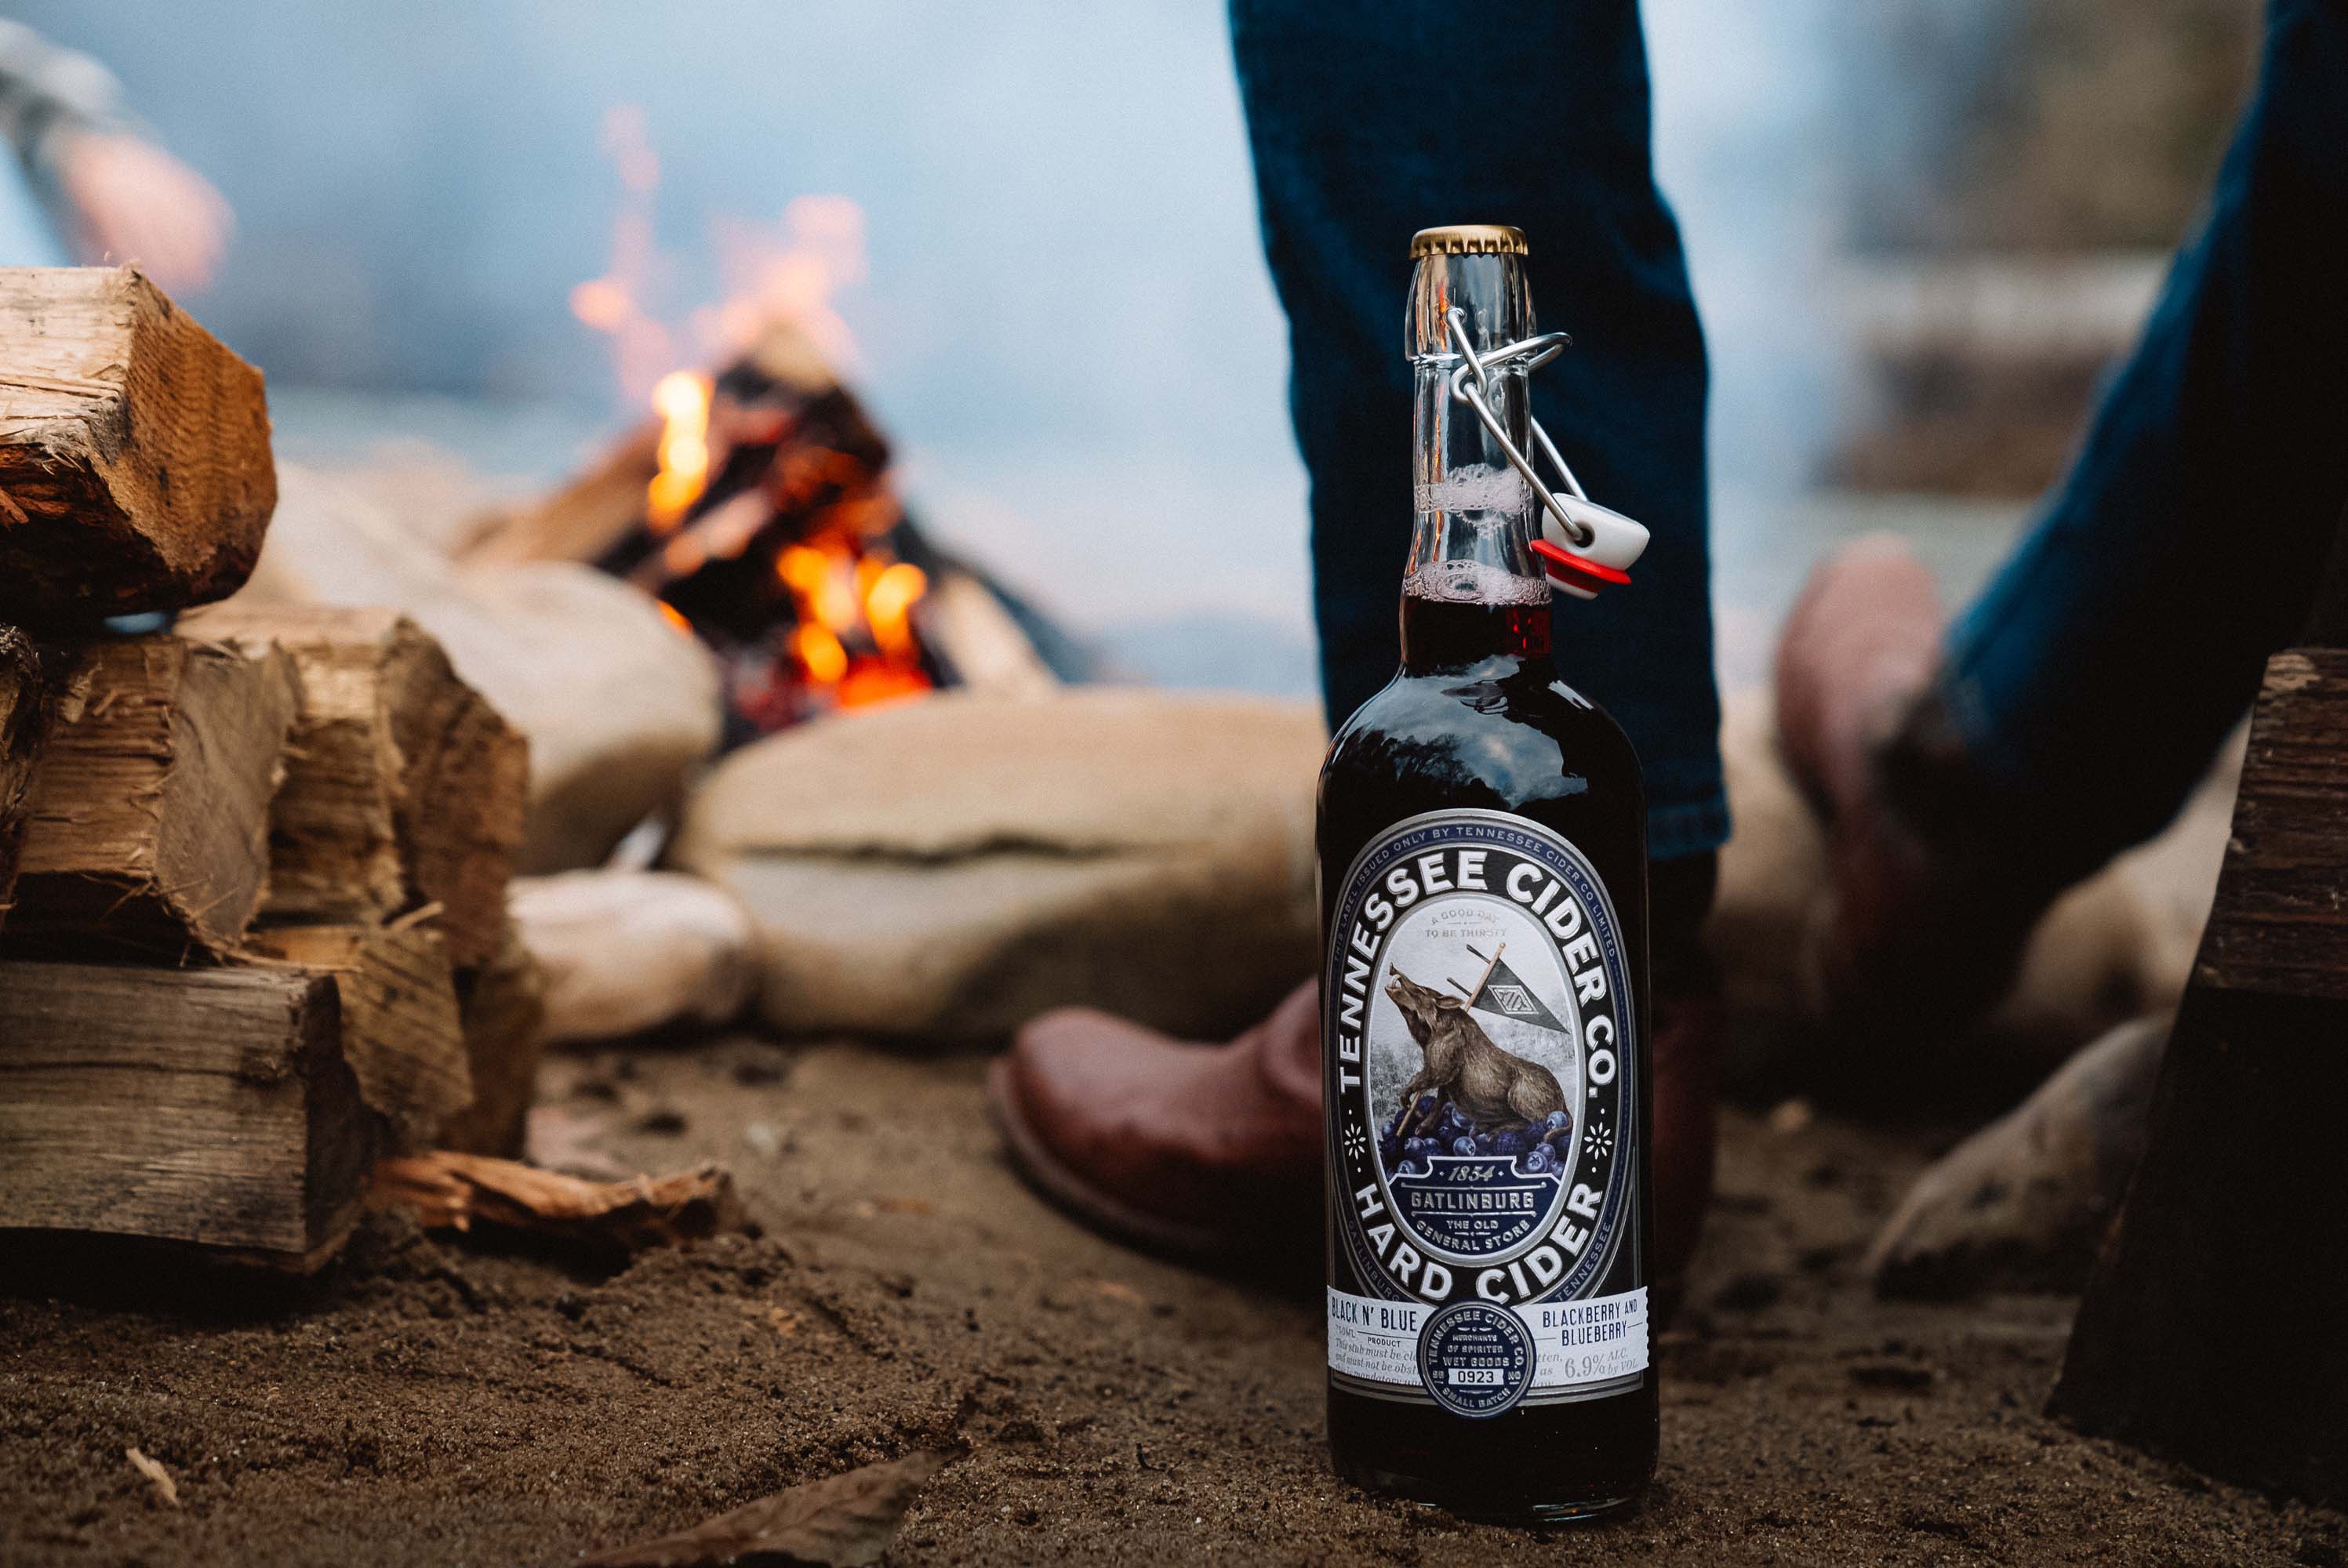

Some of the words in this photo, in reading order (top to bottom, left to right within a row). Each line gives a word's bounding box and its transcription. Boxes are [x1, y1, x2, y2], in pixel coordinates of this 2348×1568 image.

[1341, 891, 1358, 928] LABEL
[1357, 849, 1390, 887] ISSUED
[1393, 832, 1427, 851] ONLY
[1432, 828, 1449, 839] BY
[1456, 826, 1543, 853] TENNESSEE
[1547, 850, 1580, 882] CIDER
[1580, 883, 1594, 901] CO
[1431, 916, 1438, 925] A
[1441, 909, 1473, 920] GOOD
[1424, 929, 1438, 938] TO
[1339, 851, 1488, 1095] TENNESSEE
[1506, 862, 1607, 1007] CIDER
[1585, 1014, 1616, 1098] CO.
[1448, 1165, 1496, 1181] 1854
[1411, 1192, 1534, 1210] GATLINBURG
[1416, 1220, 1480, 1250] GENERAL
[1485, 1219, 1530, 1249] STORE
[1446, 1220, 1470, 1229] THE
[1474, 1220, 1499, 1229] OLD
[1355, 1183, 1454, 1301] HARD
[1475, 1183, 1603, 1305] CIDER
[1555, 1222, 1612, 1301] TENNESSEE
[1332, 1297, 1358, 1324] BLACK
[1362, 1305, 1374, 1326] N'
[1381, 1308, 1418, 1332] BLUE
[1543, 1301, 1620, 1328] BLACKBERRY
[1625, 1298, 1637, 1314] AND
[1368, 1337, 1401, 1348] PRODUCT
[1429, 1311, 1481, 1365] TENNESSEE
[1485, 1313, 1519, 1345] CIDER
[1514, 1347, 1525, 1369] CO.
[1561, 1320, 1627, 1346] BLUEBERRY
[1349, 1342, 1364, 1354] stub
[1366, 1348, 1388, 1359] must
[1390, 1349, 1401, 1360] be
[1347, 1357, 1363, 1367] must
[1365, 1359, 1379, 1370] not
[1381, 1360, 1393, 1371] be
[1443, 1357, 1466, 1367] WET
[1470, 1357, 1510, 1367] GOODS
[1565, 1354, 1605, 1378] 6.9%
[1458, 1370, 1494, 1383] 0923
[1442, 1387, 1474, 1407] SMALL
[1478, 1388, 1510, 1407] BATCH
